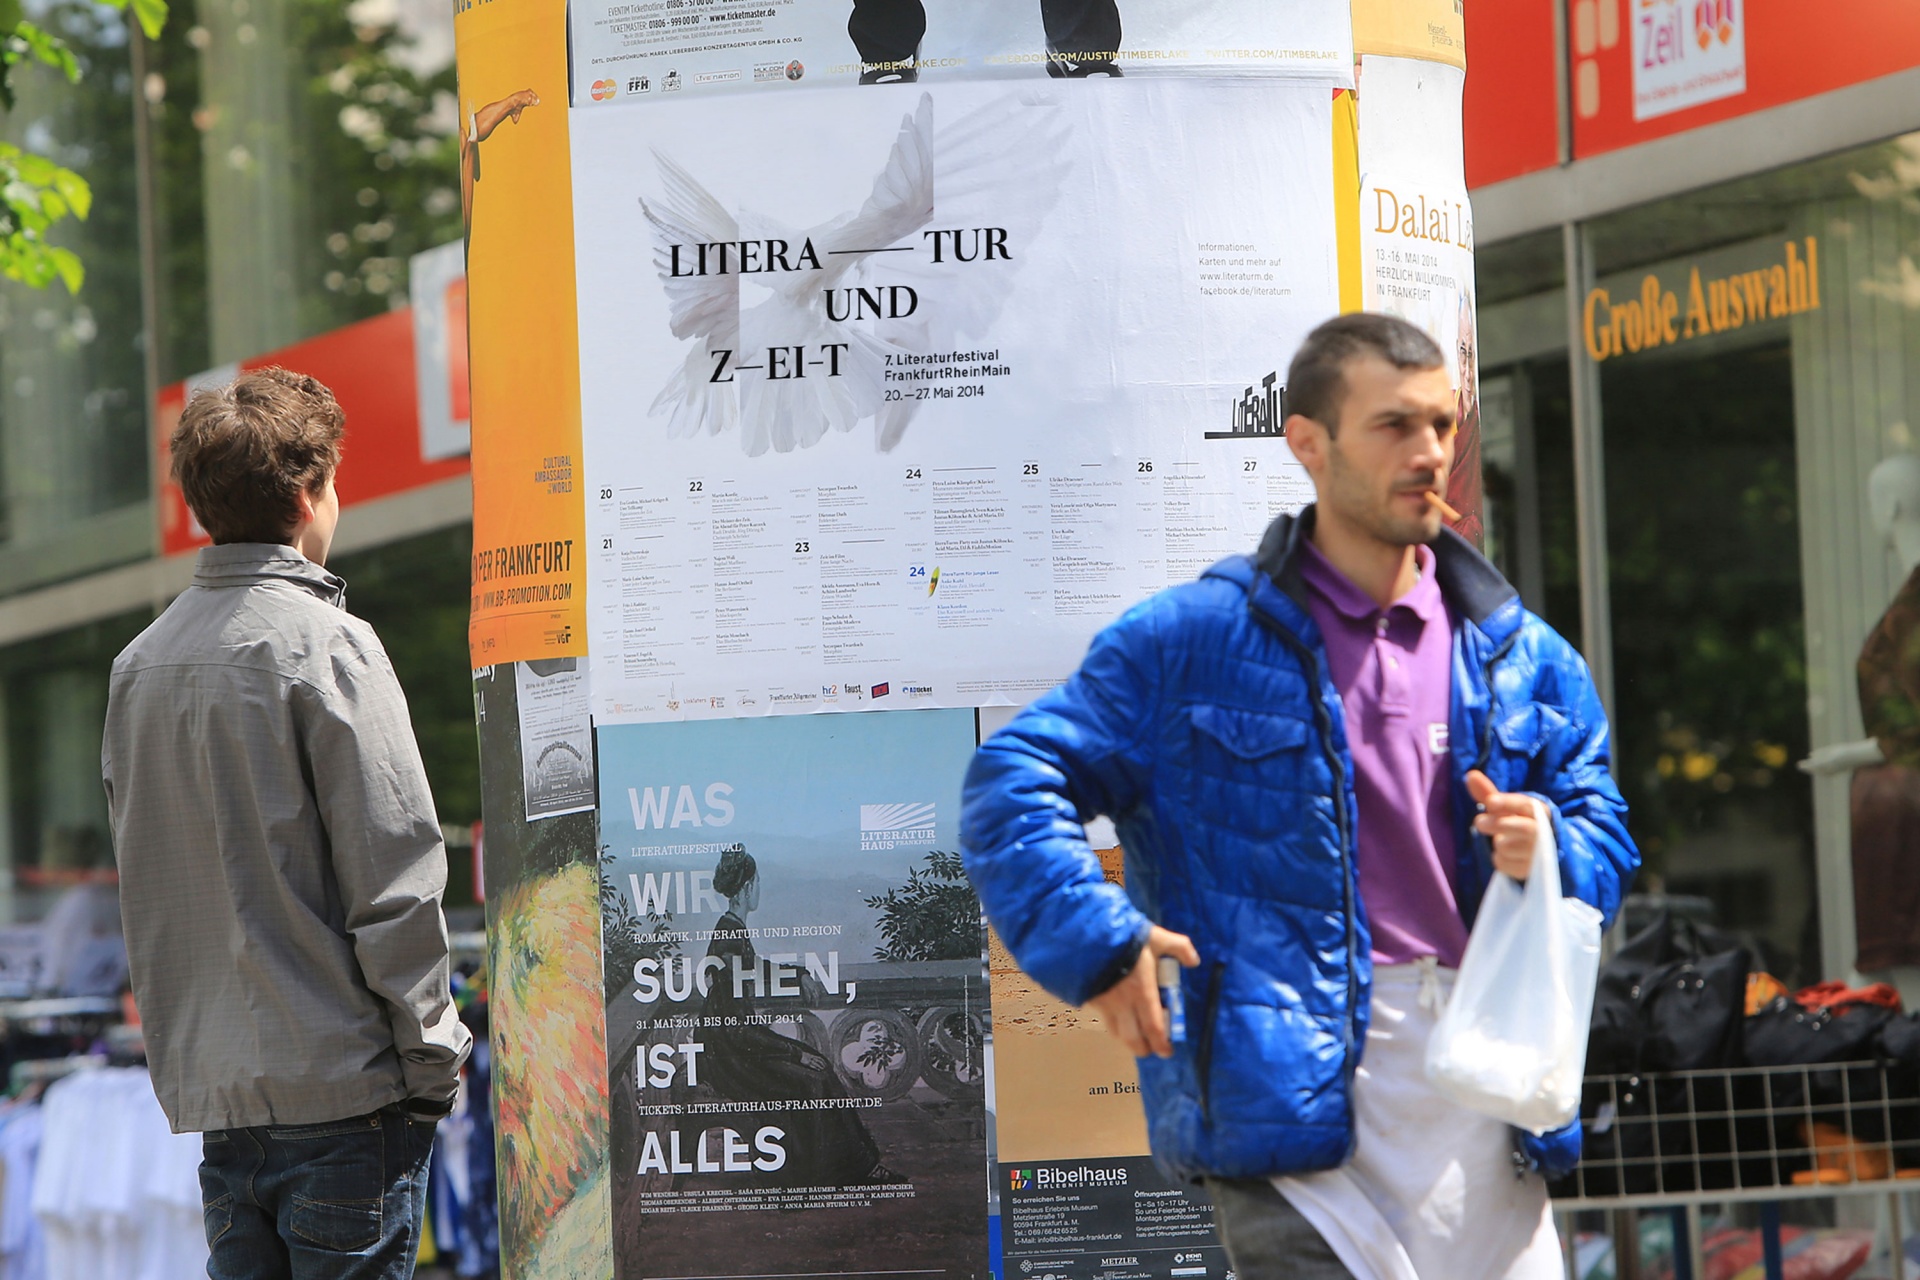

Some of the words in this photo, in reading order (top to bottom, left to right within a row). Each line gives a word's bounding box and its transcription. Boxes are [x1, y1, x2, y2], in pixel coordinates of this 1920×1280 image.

[709, 8, 776, 22] www.ticketmaster.de
[610, 22, 647, 33] TICKETMASTER:
[648, 19, 666, 29] 01806
[671, 17, 682, 26] 999
[1641, 8, 1684, 69] Zeil
[591, 57, 605, 65] ÖRTL.
[606, 52, 648, 63] DURCHFÜHRUNG:
[650, 49, 668, 57] MAREK
[669, 46, 703, 55] LIEBERBERG
[703, 41, 757, 51] KONZERTAGENTUR
[983, 50, 1189, 64] FACEBOOK.COM/JUSTINTIMBERLAKE
[1204, 49, 1339, 60] TWITTER.COM/JTIMBERLAKE
[825, 55, 968, 74] JUSTINTIMBERLAKE.COM
[628, 80, 649, 91] FFH
[1373, 188, 1450, 244] Dalai
[1198, 243, 1257, 252] Informationen,
[1199, 257, 1227, 266] Karten
[1228, 258, 1244, 266] und
[1246, 258, 1267, 266] mehr
[1269, 258, 1281, 266] auf
[1405, 252, 1420, 265] MAI
[1421, 254, 1438, 267] 2014
[1199, 272, 1274, 281] www.literaturm.de
[1376, 266, 1413, 281] HERZLICH
[1415, 271, 1456, 290] WILLKOMMEN
[1200, 287, 1291, 296] facebook.de/literaturm
[1376, 284, 1385, 295] IN
[1387, 285, 1431, 302] FRANKFURT
[823, 285, 918, 322] UND
[1584, 275, 1679, 362] Große
[1683, 236, 1821, 339] Auswahl
[885, 355, 893, 366] 7.
[897, 349, 999, 366] Literaturfestival
[885, 365, 1010, 382] FrankfurtRheinMain
[934, 387, 953, 399] Mai
[957, 385, 984, 397] 2014
[543, 455, 572, 469] CULTURAL
[1138, 461, 1153, 473] 26
[1244, 461, 1258, 472] 27
[534, 468, 572, 483] AMBASSADOR
[906, 469, 922, 479] 24
[1024, 464, 1039, 475] 25
[551, 481, 573, 494] WORLD
[690, 481, 703, 492] 22
[600, 489, 613, 499] 20
[603, 538, 613, 549] 21
[795, 542, 810, 553] 23
[494, 540, 573, 579] FRANKFURT
[909, 566, 926, 577] 24
[483, 583, 572, 610] WWW.BB-PROMOTION.COM
[822, 684, 837, 695] hr2
[628, 782, 736, 831] WAS
[860, 828, 936, 841] LITERATUR
[631, 842, 743, 858] LITERATURFESTIVAL
[860, 840, 894, 851] HAUS
[895, 838, 936, 847] FRANKFURT
[628, 870, 723, 917] WIR
[633, 931, 693, 945] ROMANTIK,
[696, 927, 760, 941] LITERATUR
[763, 926, 790, 938] UND
[793, 924, 843, 937] REGION
[632, 951, 857, 1004] SUCHEN,
[636, 1019, 651, 1030] 31.
[653, 1018, 675, 1029] MAI
[675, 1017, 701, 1028] 2014
[703, 1016, 721, 1028] BIS
[724, 1016, 740, 1027] 06.
[744, 1014, 773, 1026] JUNI
[775, 1013, 803, 1025] 2014
[636, 1043, 704, 1089] IST
[1089, 1086, 1109, 1096] am
[638, 1104, 685, 1116] TICKETS:
[687, 1097, 883, 1114] LITERATURHAUS-FRANKFURT.DE
[637, 1126, 787, 1175] ALLES
[1037, 1166, 1128, 1184] Bibelhaus
[683, 1189, 706, 1197] URSULA
[706, 1189, 733, 1197] KRECHEL
[843, 1184, 881, 1192] WOLFGANG
[881, 1183, 914, 1191] BÜSCHER
[1037, 1181, 1083, 1190] ERLEBNIS
[724, 1196, 763, 1204] OSTERMAIER
[832, 1193, 865, 1201] ZISCHLER
[1023, 1196, 1054, 1204] erreichen
[1134, 1190, 1183, 1198] Öffnungszeiten
[640, 1207, 659, 1215] EDGAR
[785, 1202, 803, 1210] ANNA
[803, 1201, 825, 1209] MARIA
[826, 1200, 849, 1208] STURM
[1013, 1207, 1043, 1215] Bibelhaus
[1045, 1205, 1070, 1213] Erlebnis
[1071, 1204, 1098, 1212] Museum
[1158, 1207, 1187, 1216] Feiertage
[1013, 1213, 1056, 1222] Metzlerstraße
[1034, 1220, 1063, 1228] Frankfurt
[1135, 1215, 1162, 1223] Montags
[1163, 1214, 1200, 1223] geschlossen
[1136, 1224, 1180, 1232] Gruppenführungen
[1191, 1229, 1210, 1237] möglich
[1014, 1237, 1037, 1245] E-Mail:
[1037, 1232, 1122, 1244] info@bibelhaus-frankfurt.de
[1101, 1257, 1138, 1266] METZLER
